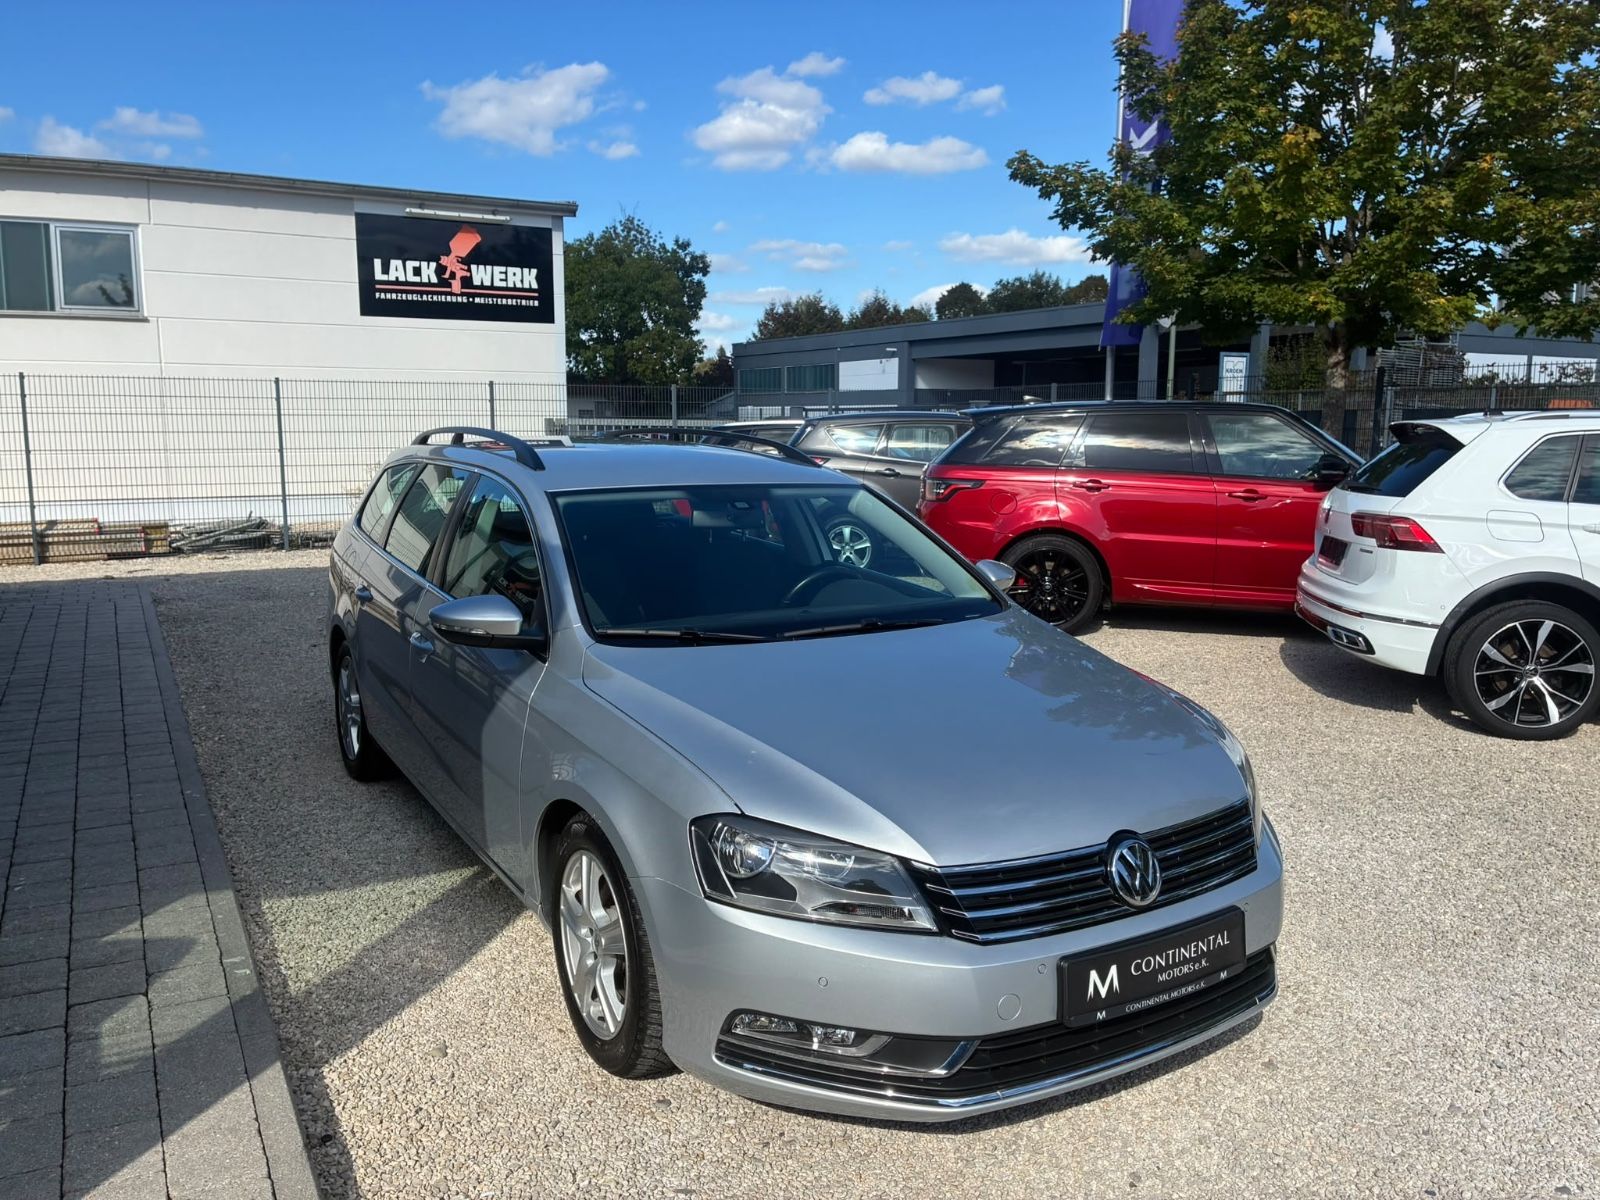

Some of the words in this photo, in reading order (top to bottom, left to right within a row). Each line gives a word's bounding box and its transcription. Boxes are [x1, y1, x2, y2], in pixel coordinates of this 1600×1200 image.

[373, 258, 438, 283] LACK
[470, 264, 539, 289] WERK
[375, 292, 468, 303] FAHRZEUGLACKIERUNG
[474, 297, 539, 307] MEISTERBETRIEB
[1131, 930, 1230, 976] CONTINENTAL
[1157, 963, 1194, 983] MOTORS
[1194, 957, 1210, 970] e.K.
[1125, 994, 1169, 1012] CONTINENTAL
[1170, 984, 1196, 998] MOTORS
